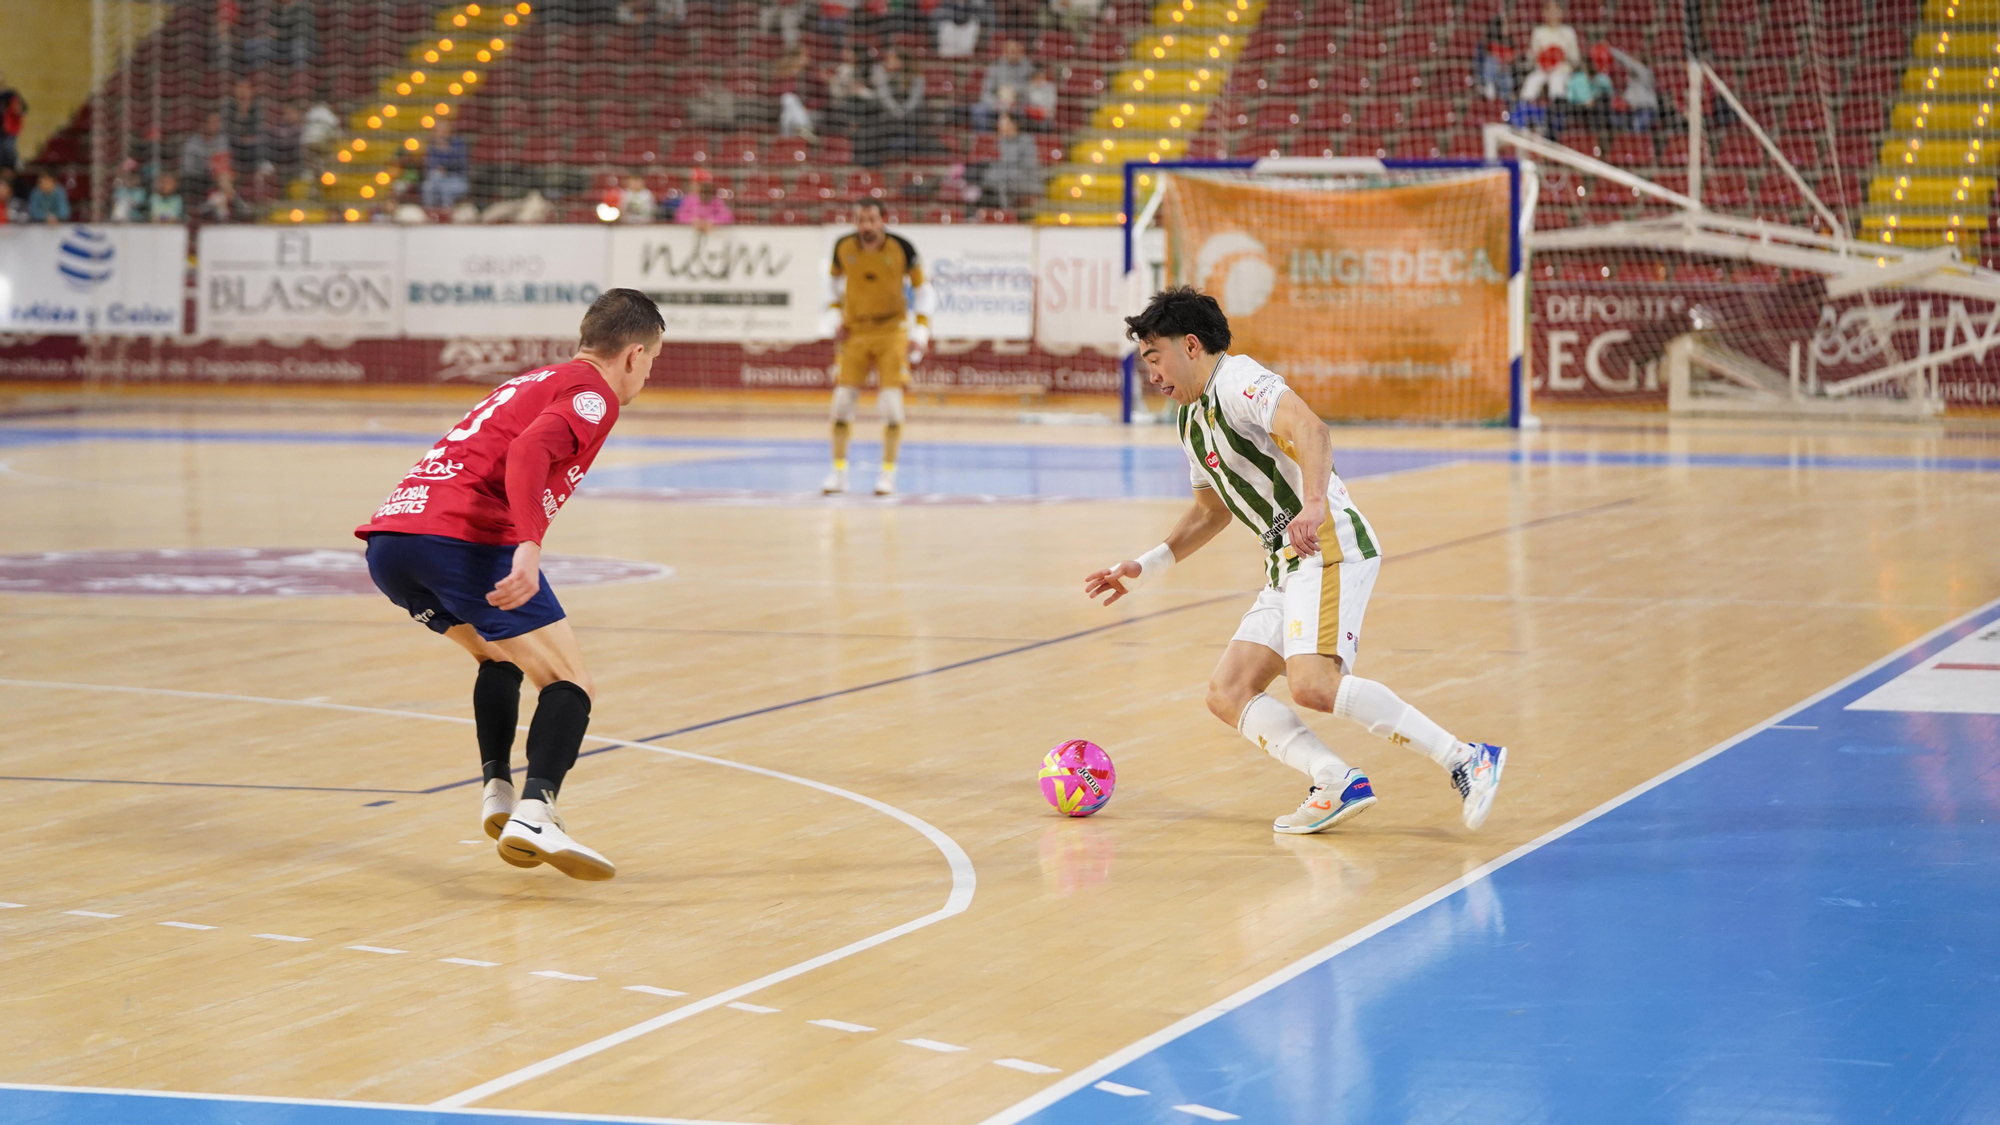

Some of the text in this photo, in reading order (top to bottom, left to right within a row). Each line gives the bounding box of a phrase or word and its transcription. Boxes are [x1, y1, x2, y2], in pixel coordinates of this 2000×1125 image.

[276, 229, 312, 268] EL
[463, 254, 547, 278] GRUPO
[931, 257, 1034, 292] Sierra
[1289, 247, 1502, 285] INGEDECA
[209, 267, 392, 317] BLASÓN
[409, 280, 600, 304] ROSMARINO
[938, 293, 1033, 315] Morena
[391, 485, 430, 502] GLOBAL
